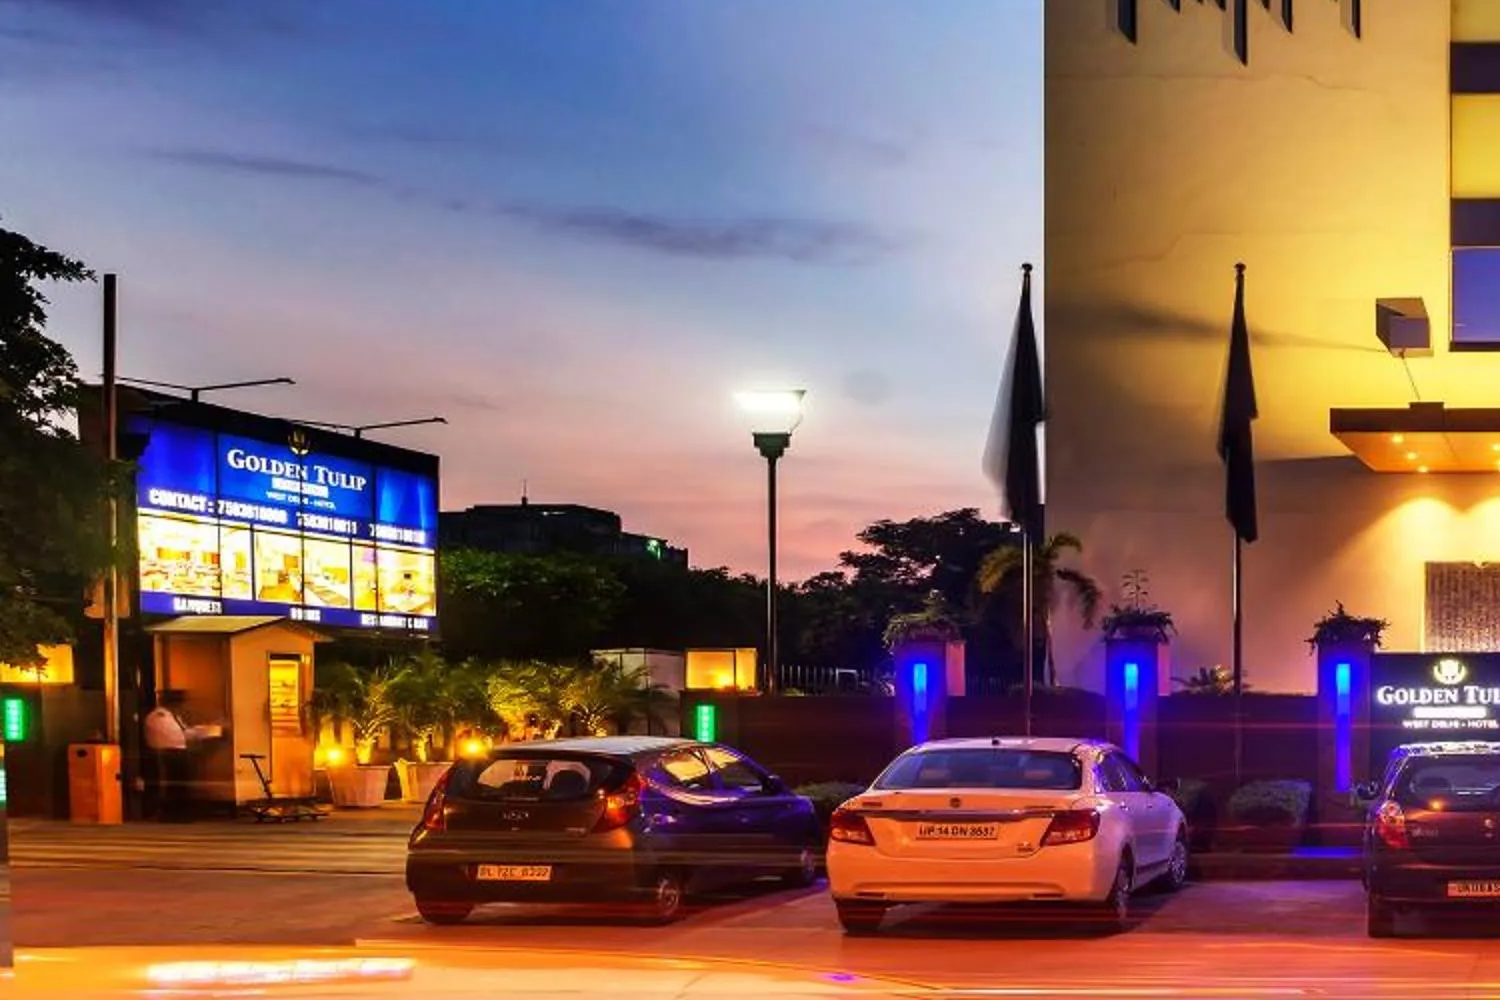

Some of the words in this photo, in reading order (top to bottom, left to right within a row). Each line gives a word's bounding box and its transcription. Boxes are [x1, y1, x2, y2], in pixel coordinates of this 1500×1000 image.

[227, 449, 308, 480] GOLDEN
[313, 465, 367, 491] TULIP
[1376, 686, 1458, 704] GOLDEN
